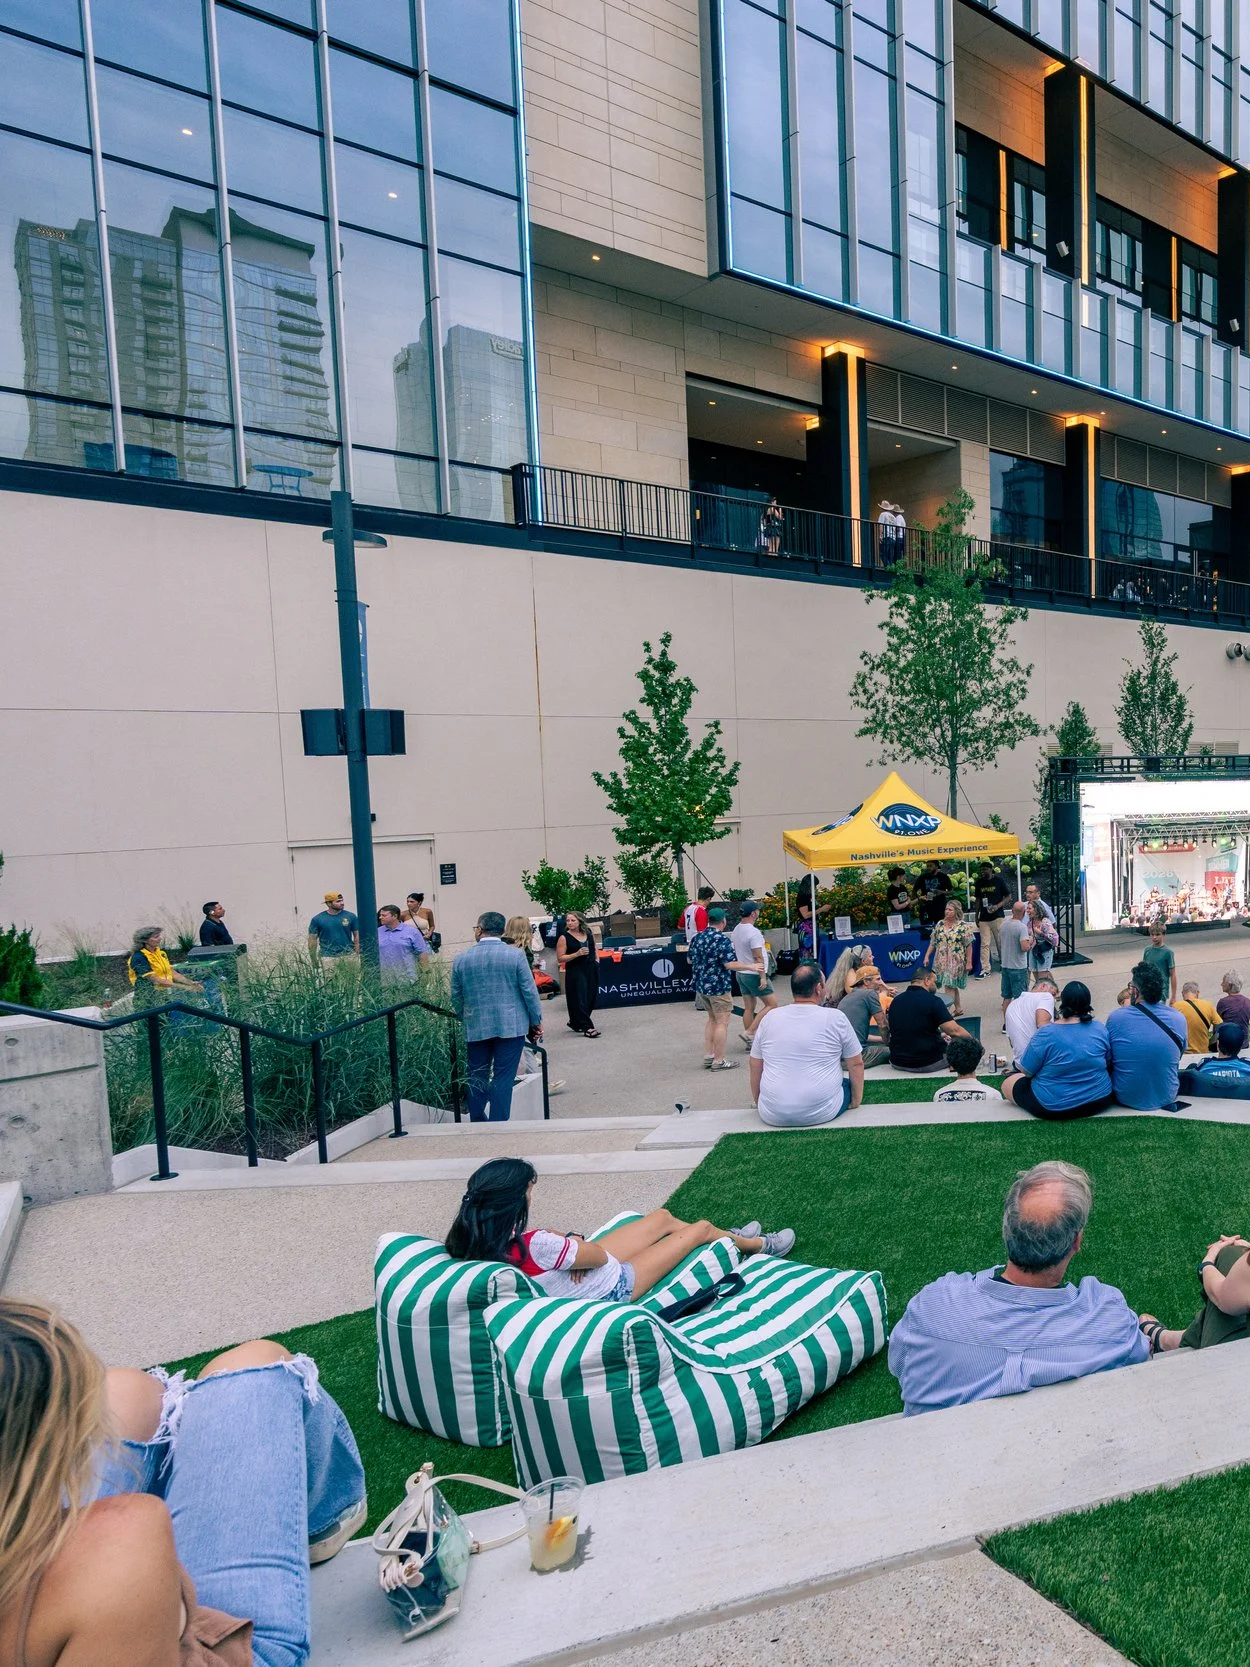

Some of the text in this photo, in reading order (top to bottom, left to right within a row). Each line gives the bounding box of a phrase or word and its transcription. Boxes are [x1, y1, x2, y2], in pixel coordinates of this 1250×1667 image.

[870, 813, 942, 829] WNXP
[850, 844, 988, 861] Nashville's Music Experience
[889, 950, 921, 960] WNXP
[621, 988, 673, 998] UNEQUALED
